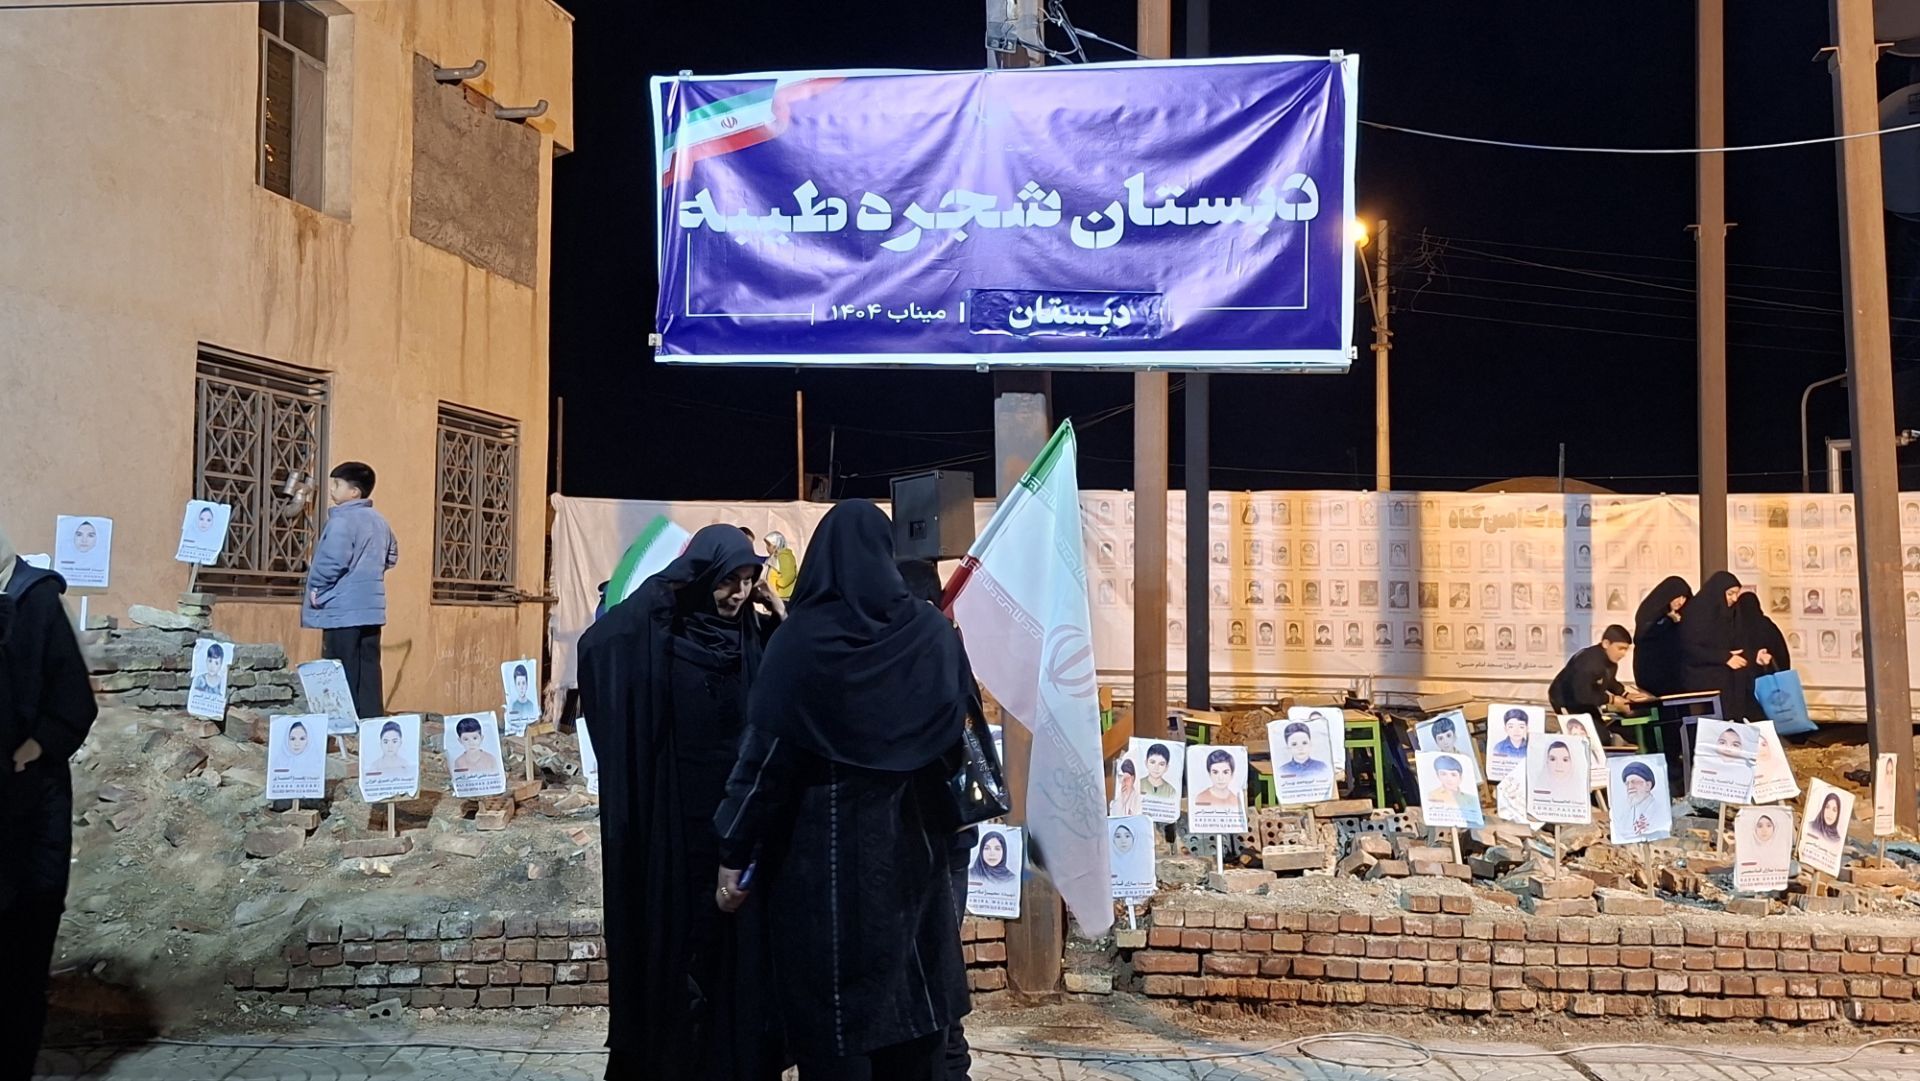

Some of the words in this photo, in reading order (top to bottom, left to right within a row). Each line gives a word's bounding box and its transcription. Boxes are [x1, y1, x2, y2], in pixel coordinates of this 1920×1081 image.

[679, 179, 848, 245] طیبه
[856, 180, 1062, 252] شجره
[1070, 171, 1319, 249] دبستان
[831, 303, 882, 320] ۱۴۰۴
[887, 301, 946, 324] میناب
[1008, 295, 1131, 337] دبستان
